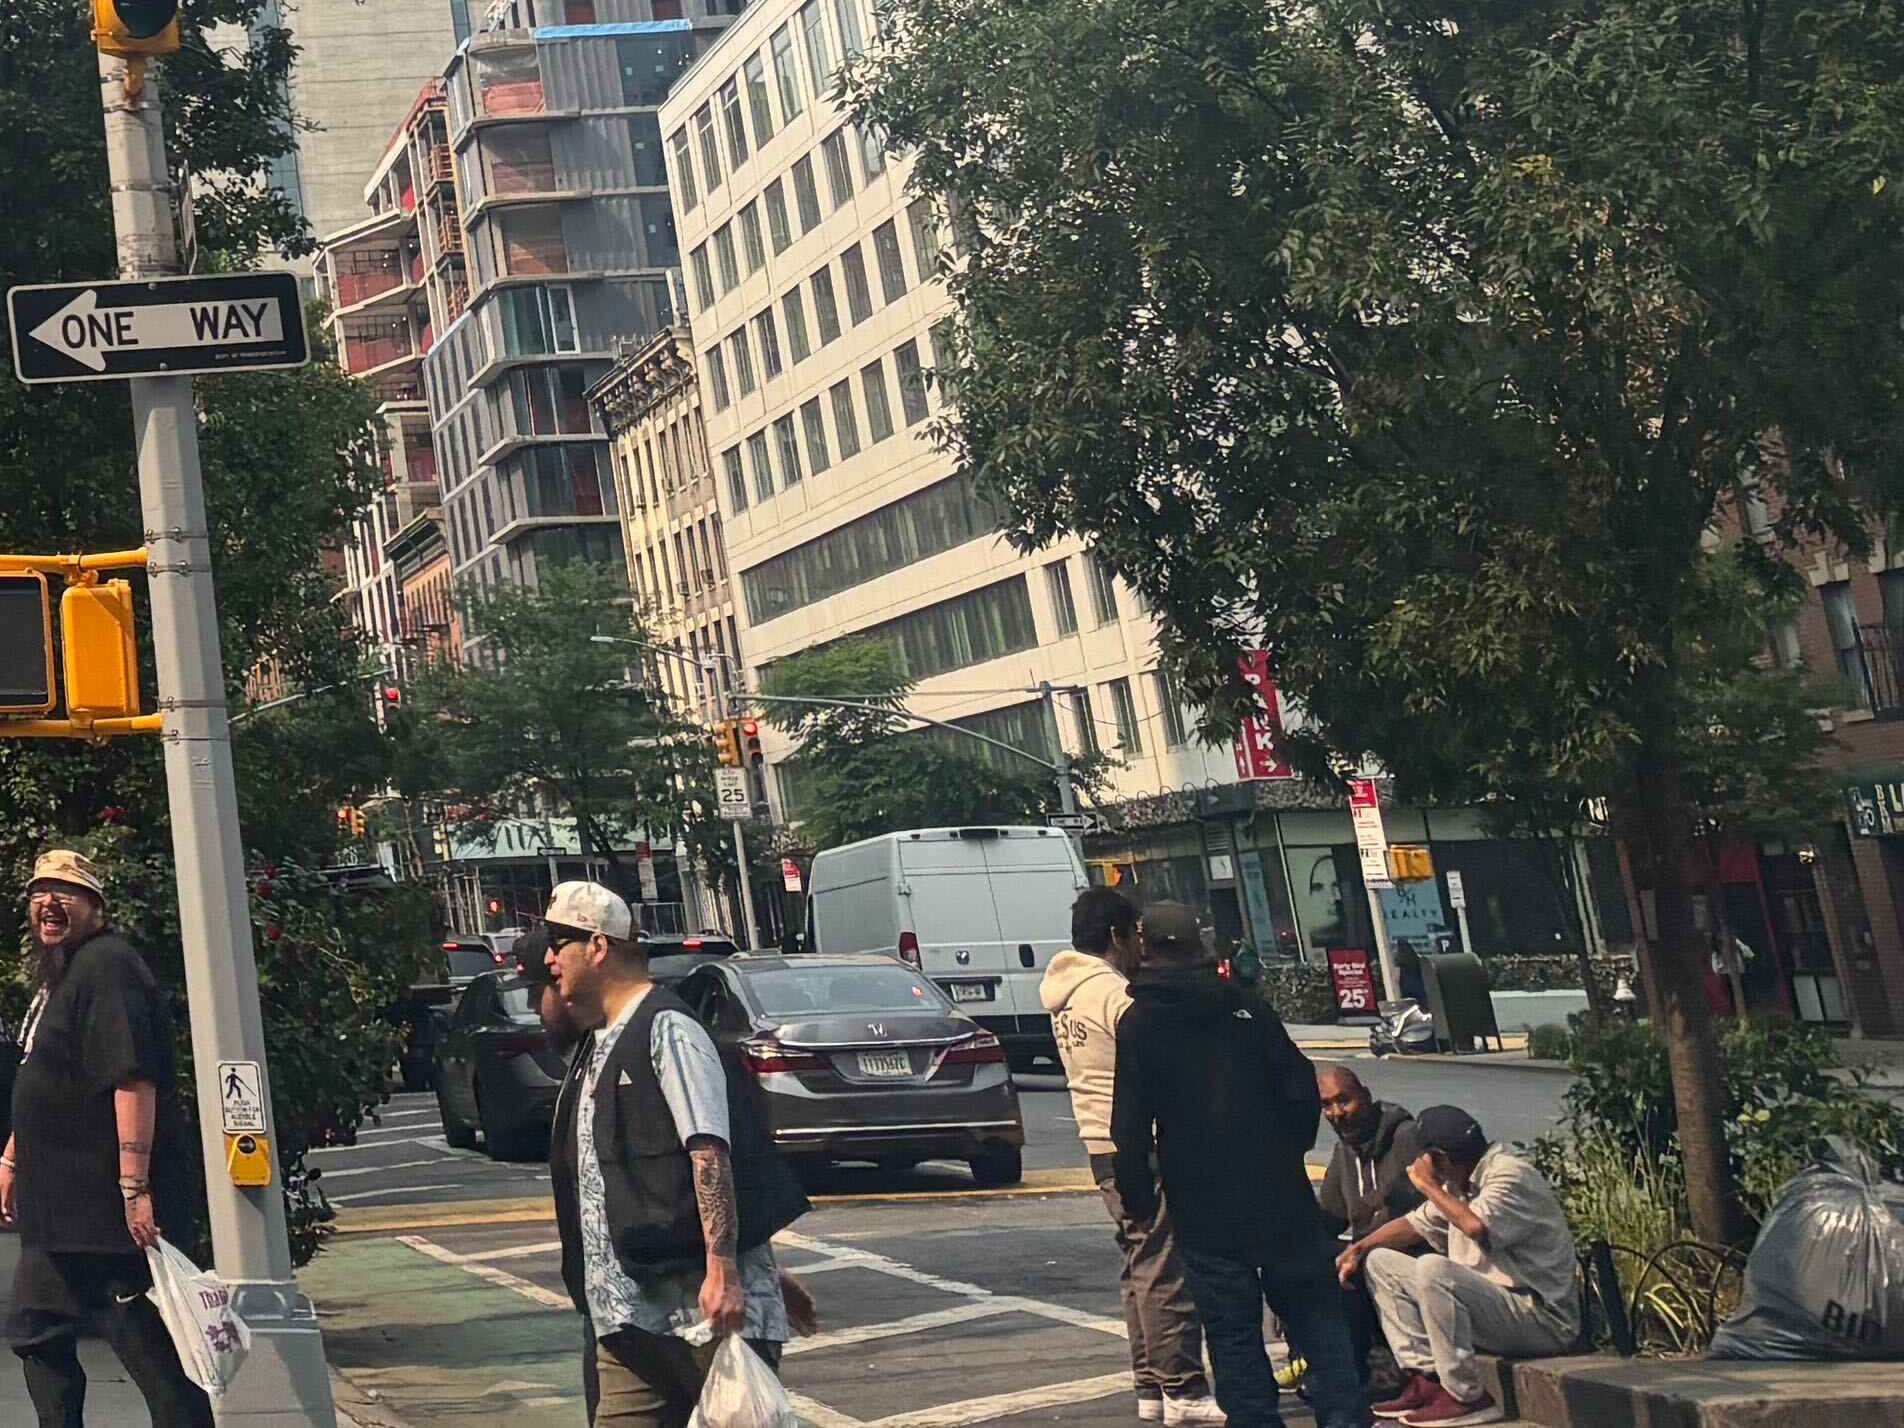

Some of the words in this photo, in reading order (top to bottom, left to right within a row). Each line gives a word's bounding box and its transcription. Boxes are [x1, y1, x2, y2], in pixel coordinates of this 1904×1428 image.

[61, 311, 139, 349] ONE
[189, 302, 268, 341] WAY
[721, 788, 744, 802] 25
